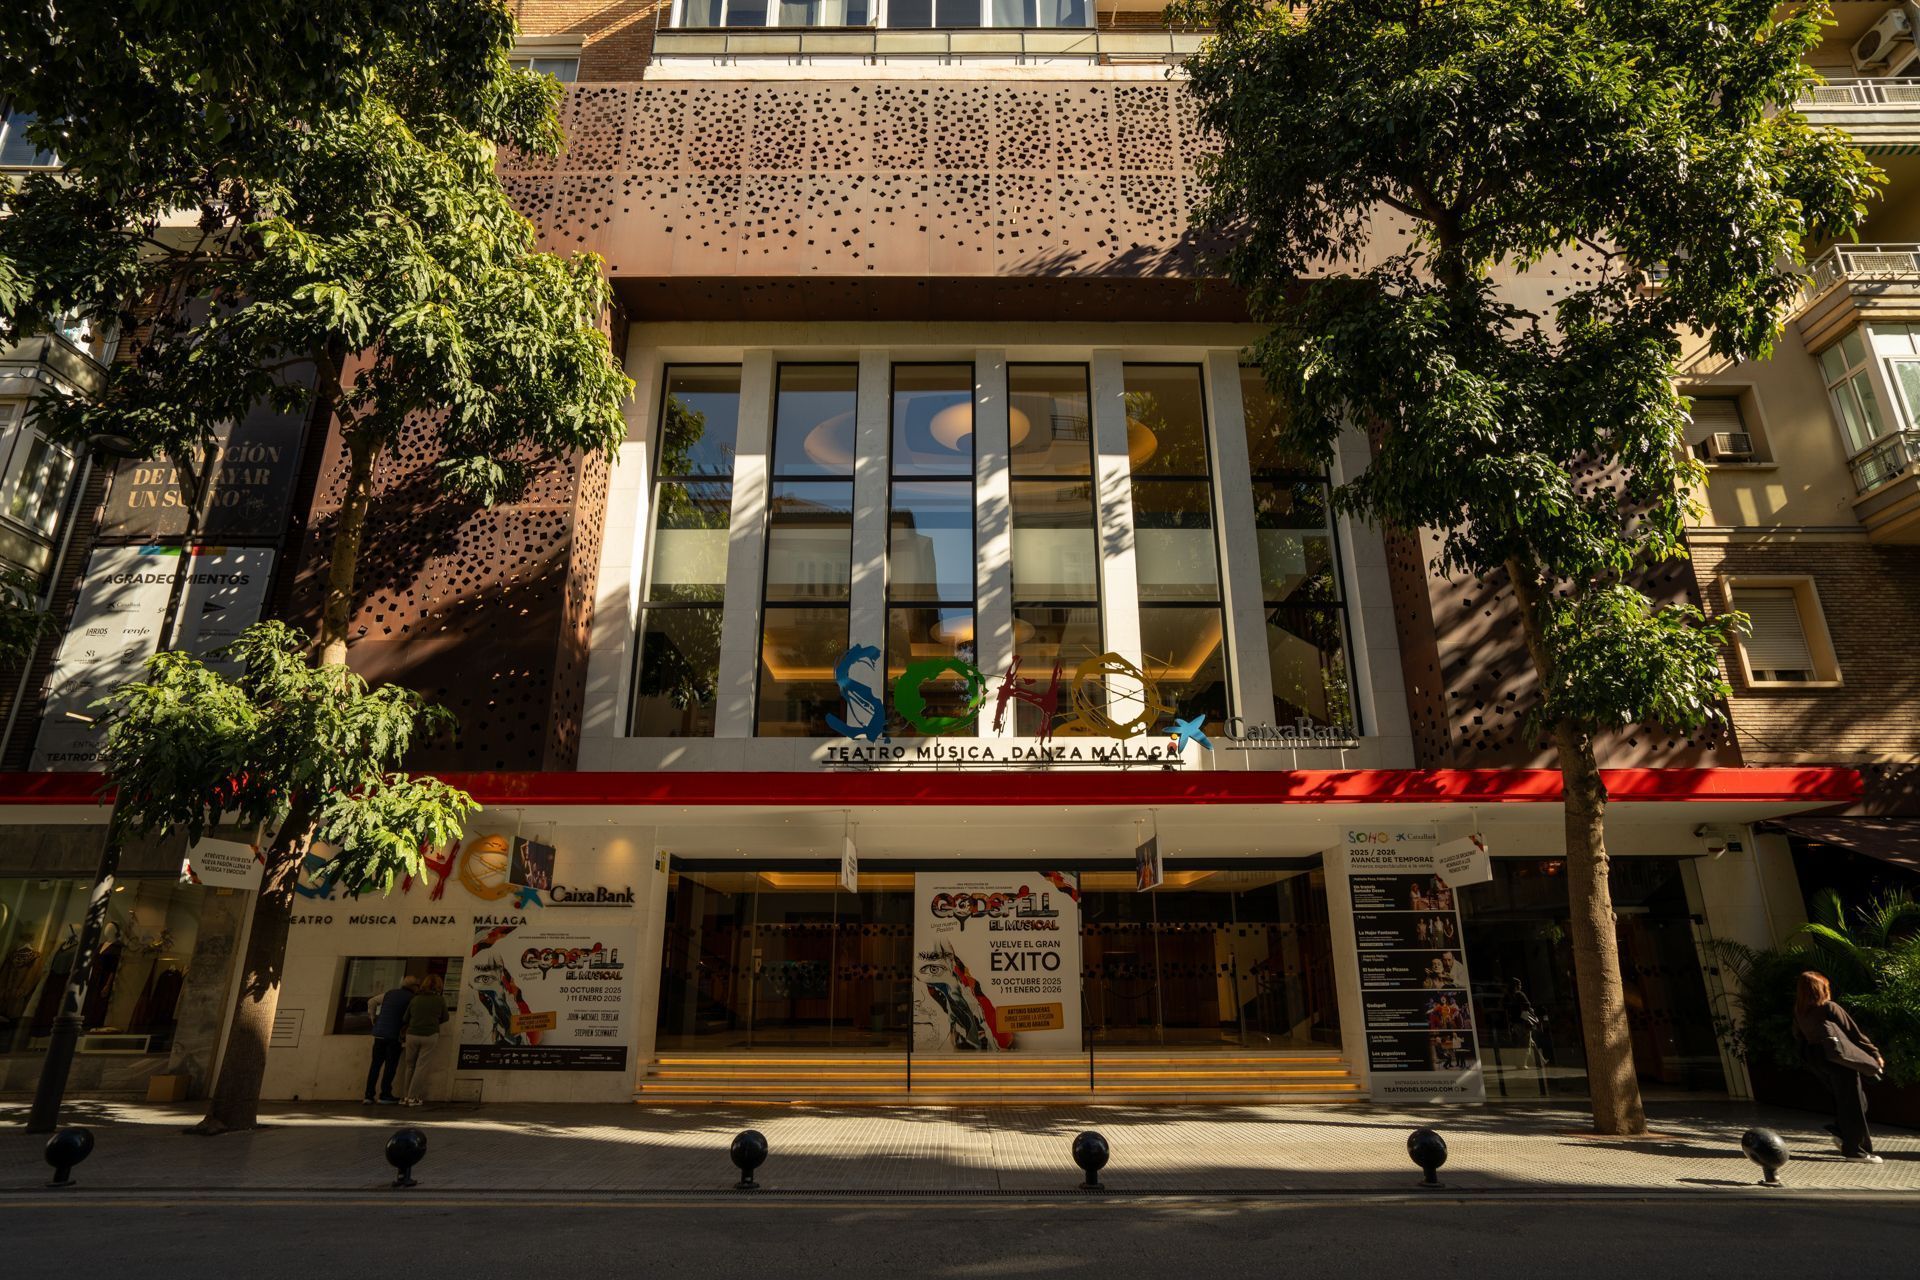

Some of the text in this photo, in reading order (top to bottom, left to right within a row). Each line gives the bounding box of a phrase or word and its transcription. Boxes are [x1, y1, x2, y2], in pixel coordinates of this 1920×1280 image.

[183, 441, 282, 462] MOCIÓN
[132, 467, 271, 485] DE EAYAR
[128, 490, 159, 507] UN
[103, 573, 249, 586] AGRADECMIENTOS
[122, 627, 150, 636] renfe
[824, 643, 1176, 745] SOHO
[1223, 716, 1361, 743] CaixaBank
[827, 742, 1179, 760] TEATRO MÚSICA DANZA MÁLAGA
[1348, 831, 1389, 844] SOHO
[549, 885, 636, 904] CaixaBank
[931, 886, 1059, 919] GODSPELL
[348, 913, 398, 926] MÚSICA
[411, 915, 457, 926] DANZA
[472, 912, 528, 926] MÁLAGA
[989, 919, 1060, 931] EL MUSICAL
[989, 940, 1061, 948] VUELVE EL GRAN
[521, 943, 624, 971] GODSPELL
[991, 949, 1061, 971] ÉXITO
[566, 971, 623, 981] EL MUSICAL
[991, 977, 1062, 985] 30 OCTUBRE 2025
[574, 1029, 618, 1037] STEPHEN SCHWARTZ
